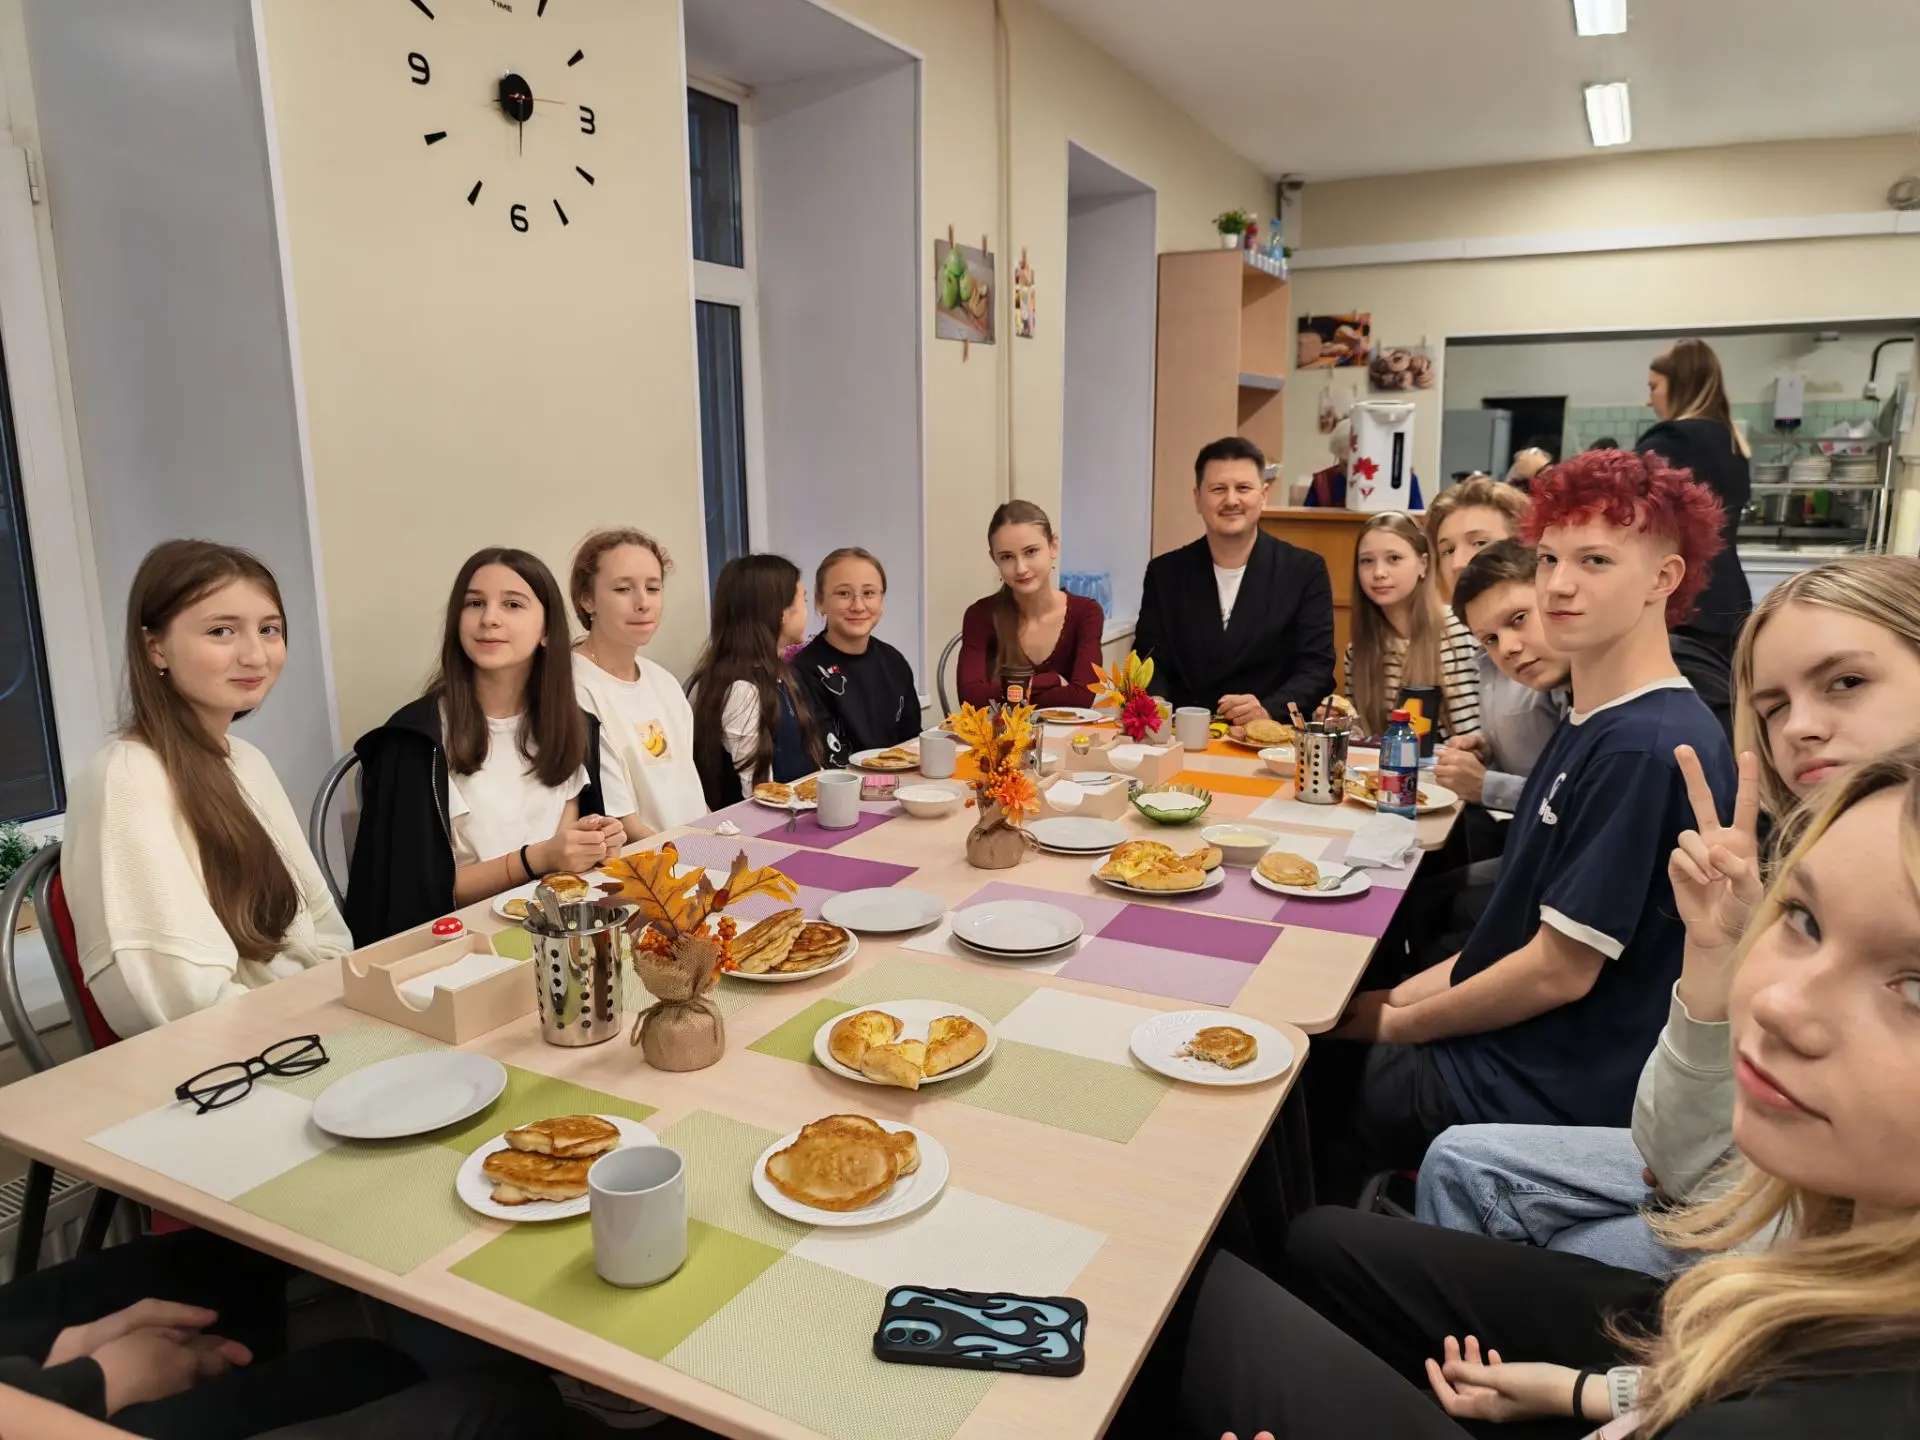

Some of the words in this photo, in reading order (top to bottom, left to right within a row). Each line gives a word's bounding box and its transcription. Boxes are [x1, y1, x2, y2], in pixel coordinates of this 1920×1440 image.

[491, 0, 513, 13] TIME
[407, 52, 430, 85] 9
[579, 105, 596, 135] 3
[510, 204, 529, 233] 6
